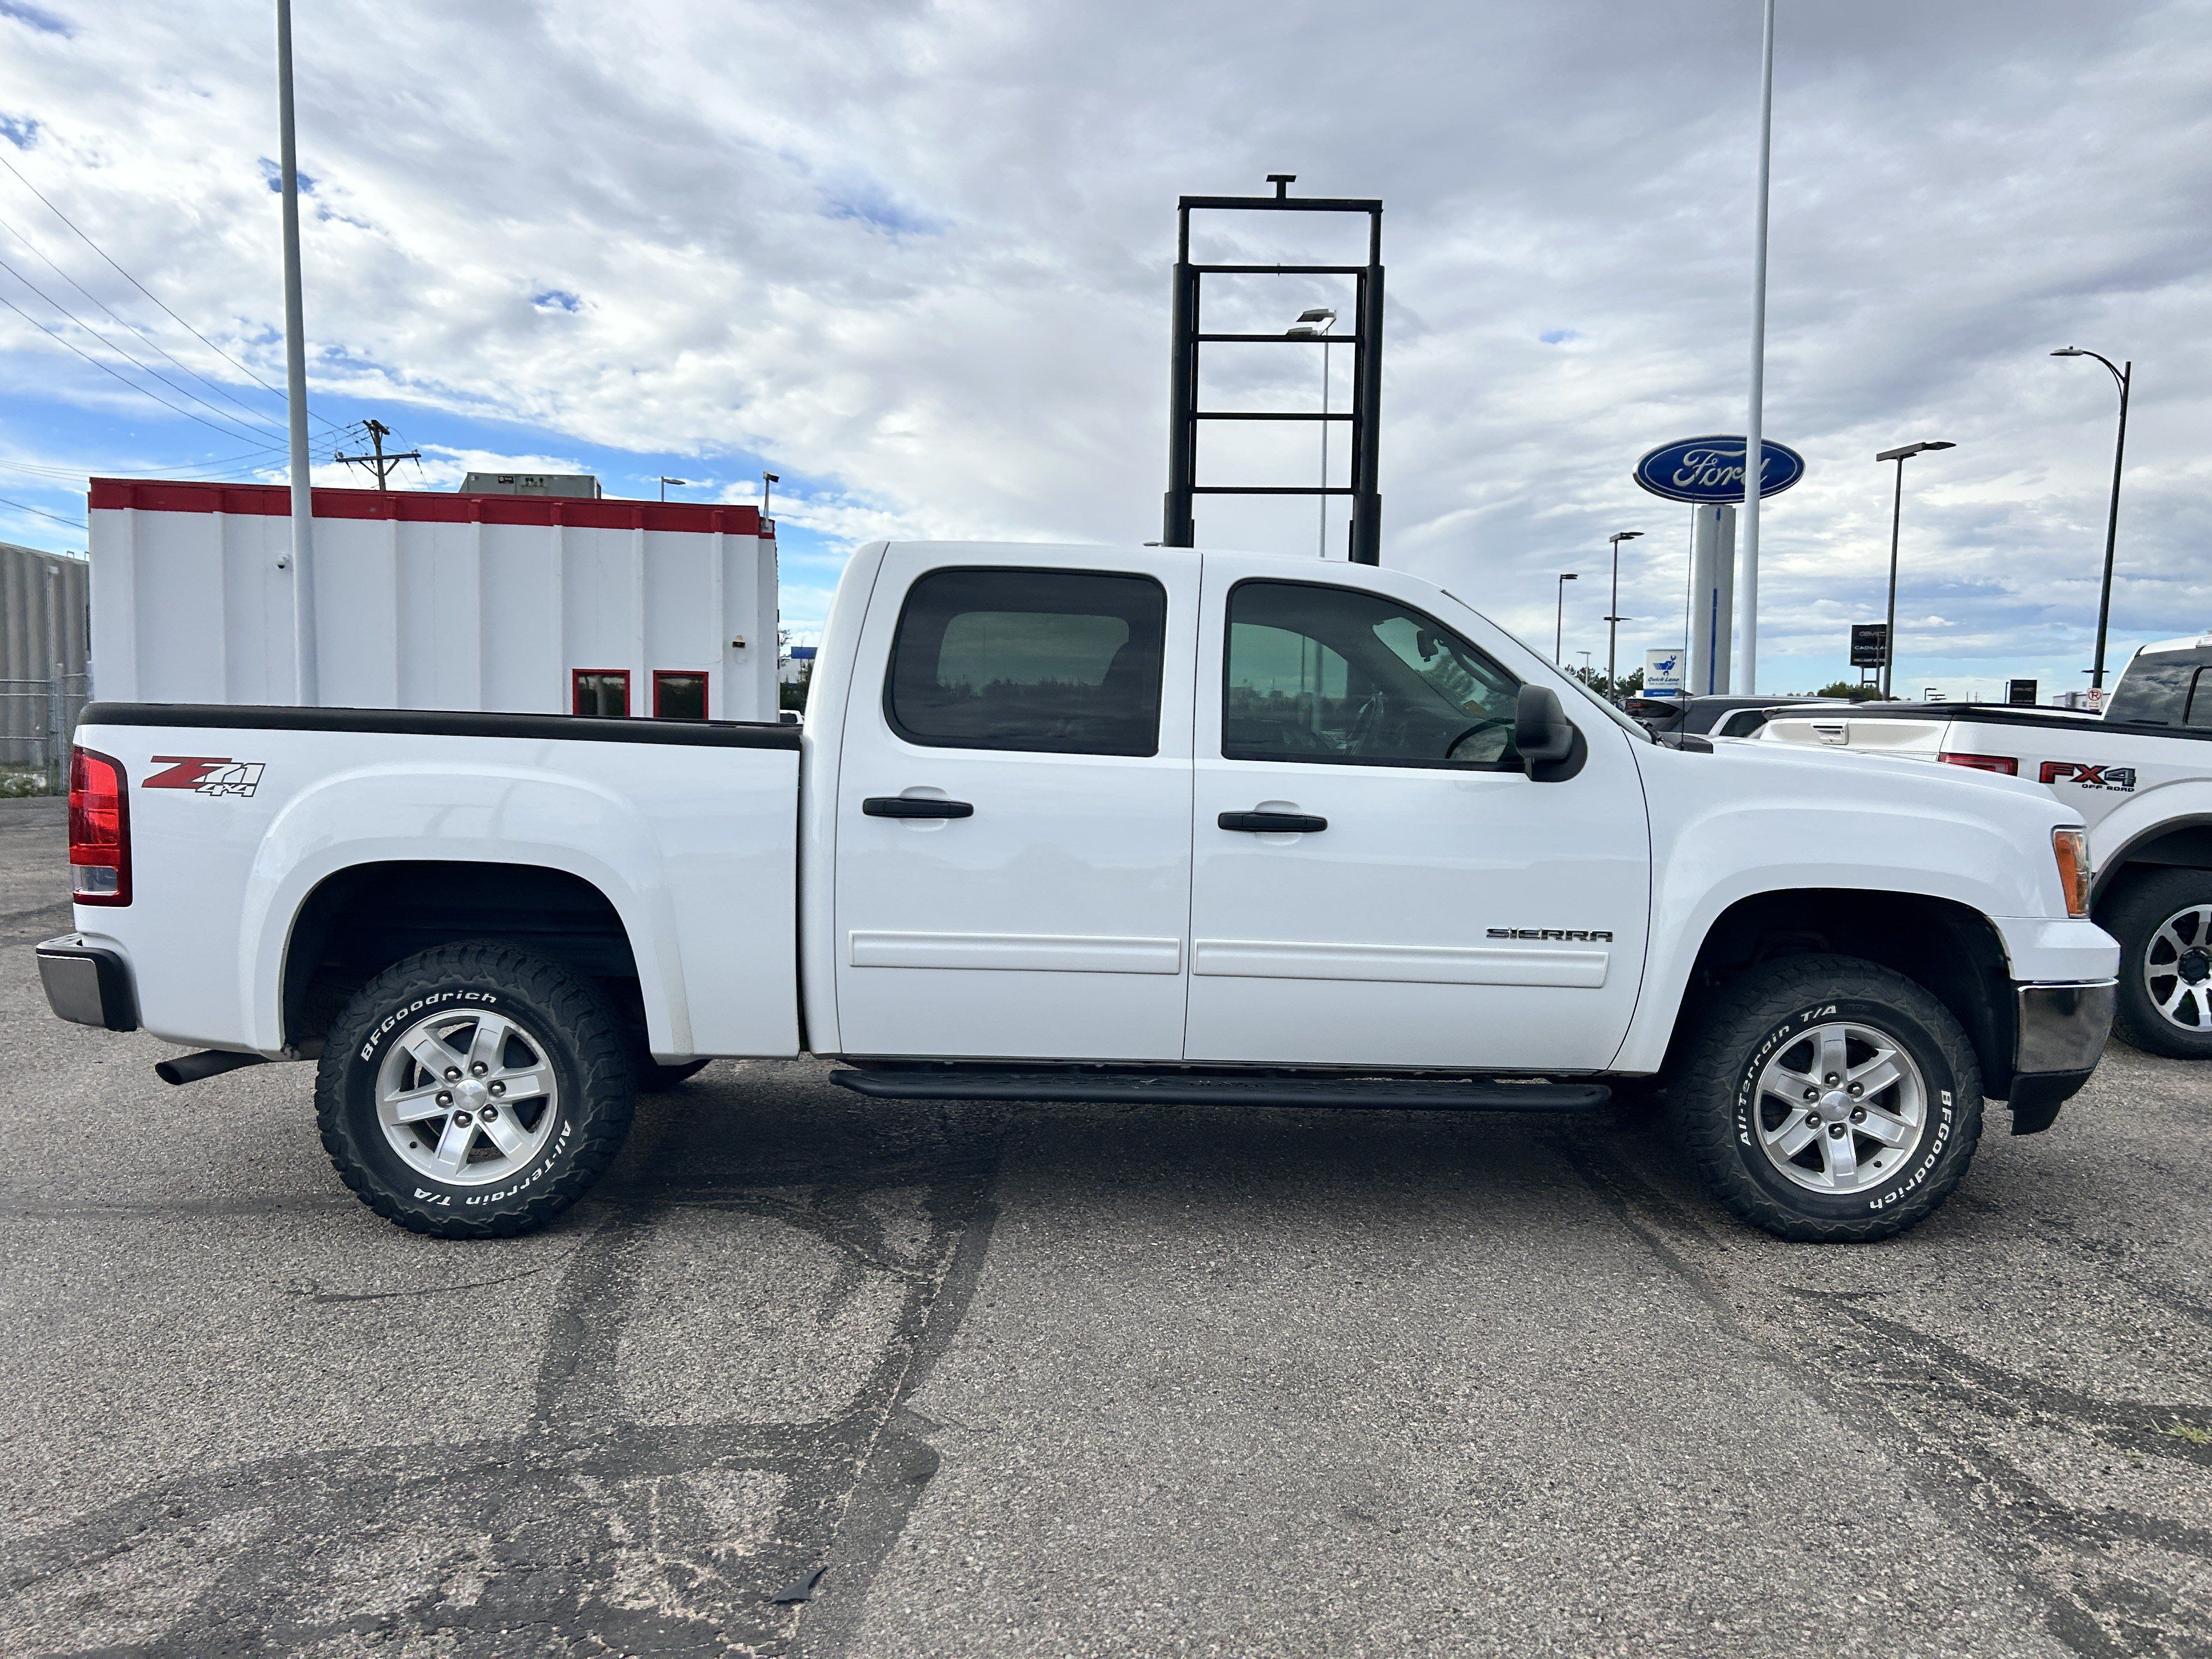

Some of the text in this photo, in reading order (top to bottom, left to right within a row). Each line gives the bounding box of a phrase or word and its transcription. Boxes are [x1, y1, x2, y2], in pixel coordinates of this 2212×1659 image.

[141, 755, 266, 789] Z71
[2039, 760, 2137, 787] FX4
[1486, 927, 1613, 943] SIERRA
[360, 990, 498, 1062] BFGoodrich
[1737, 1004, 1837, 1147] All-Terrain T/A
[413, 1120, 572, 1206] All-Terrain T/A
[1869, 1089, 1953, 1209] BFGoodrich
